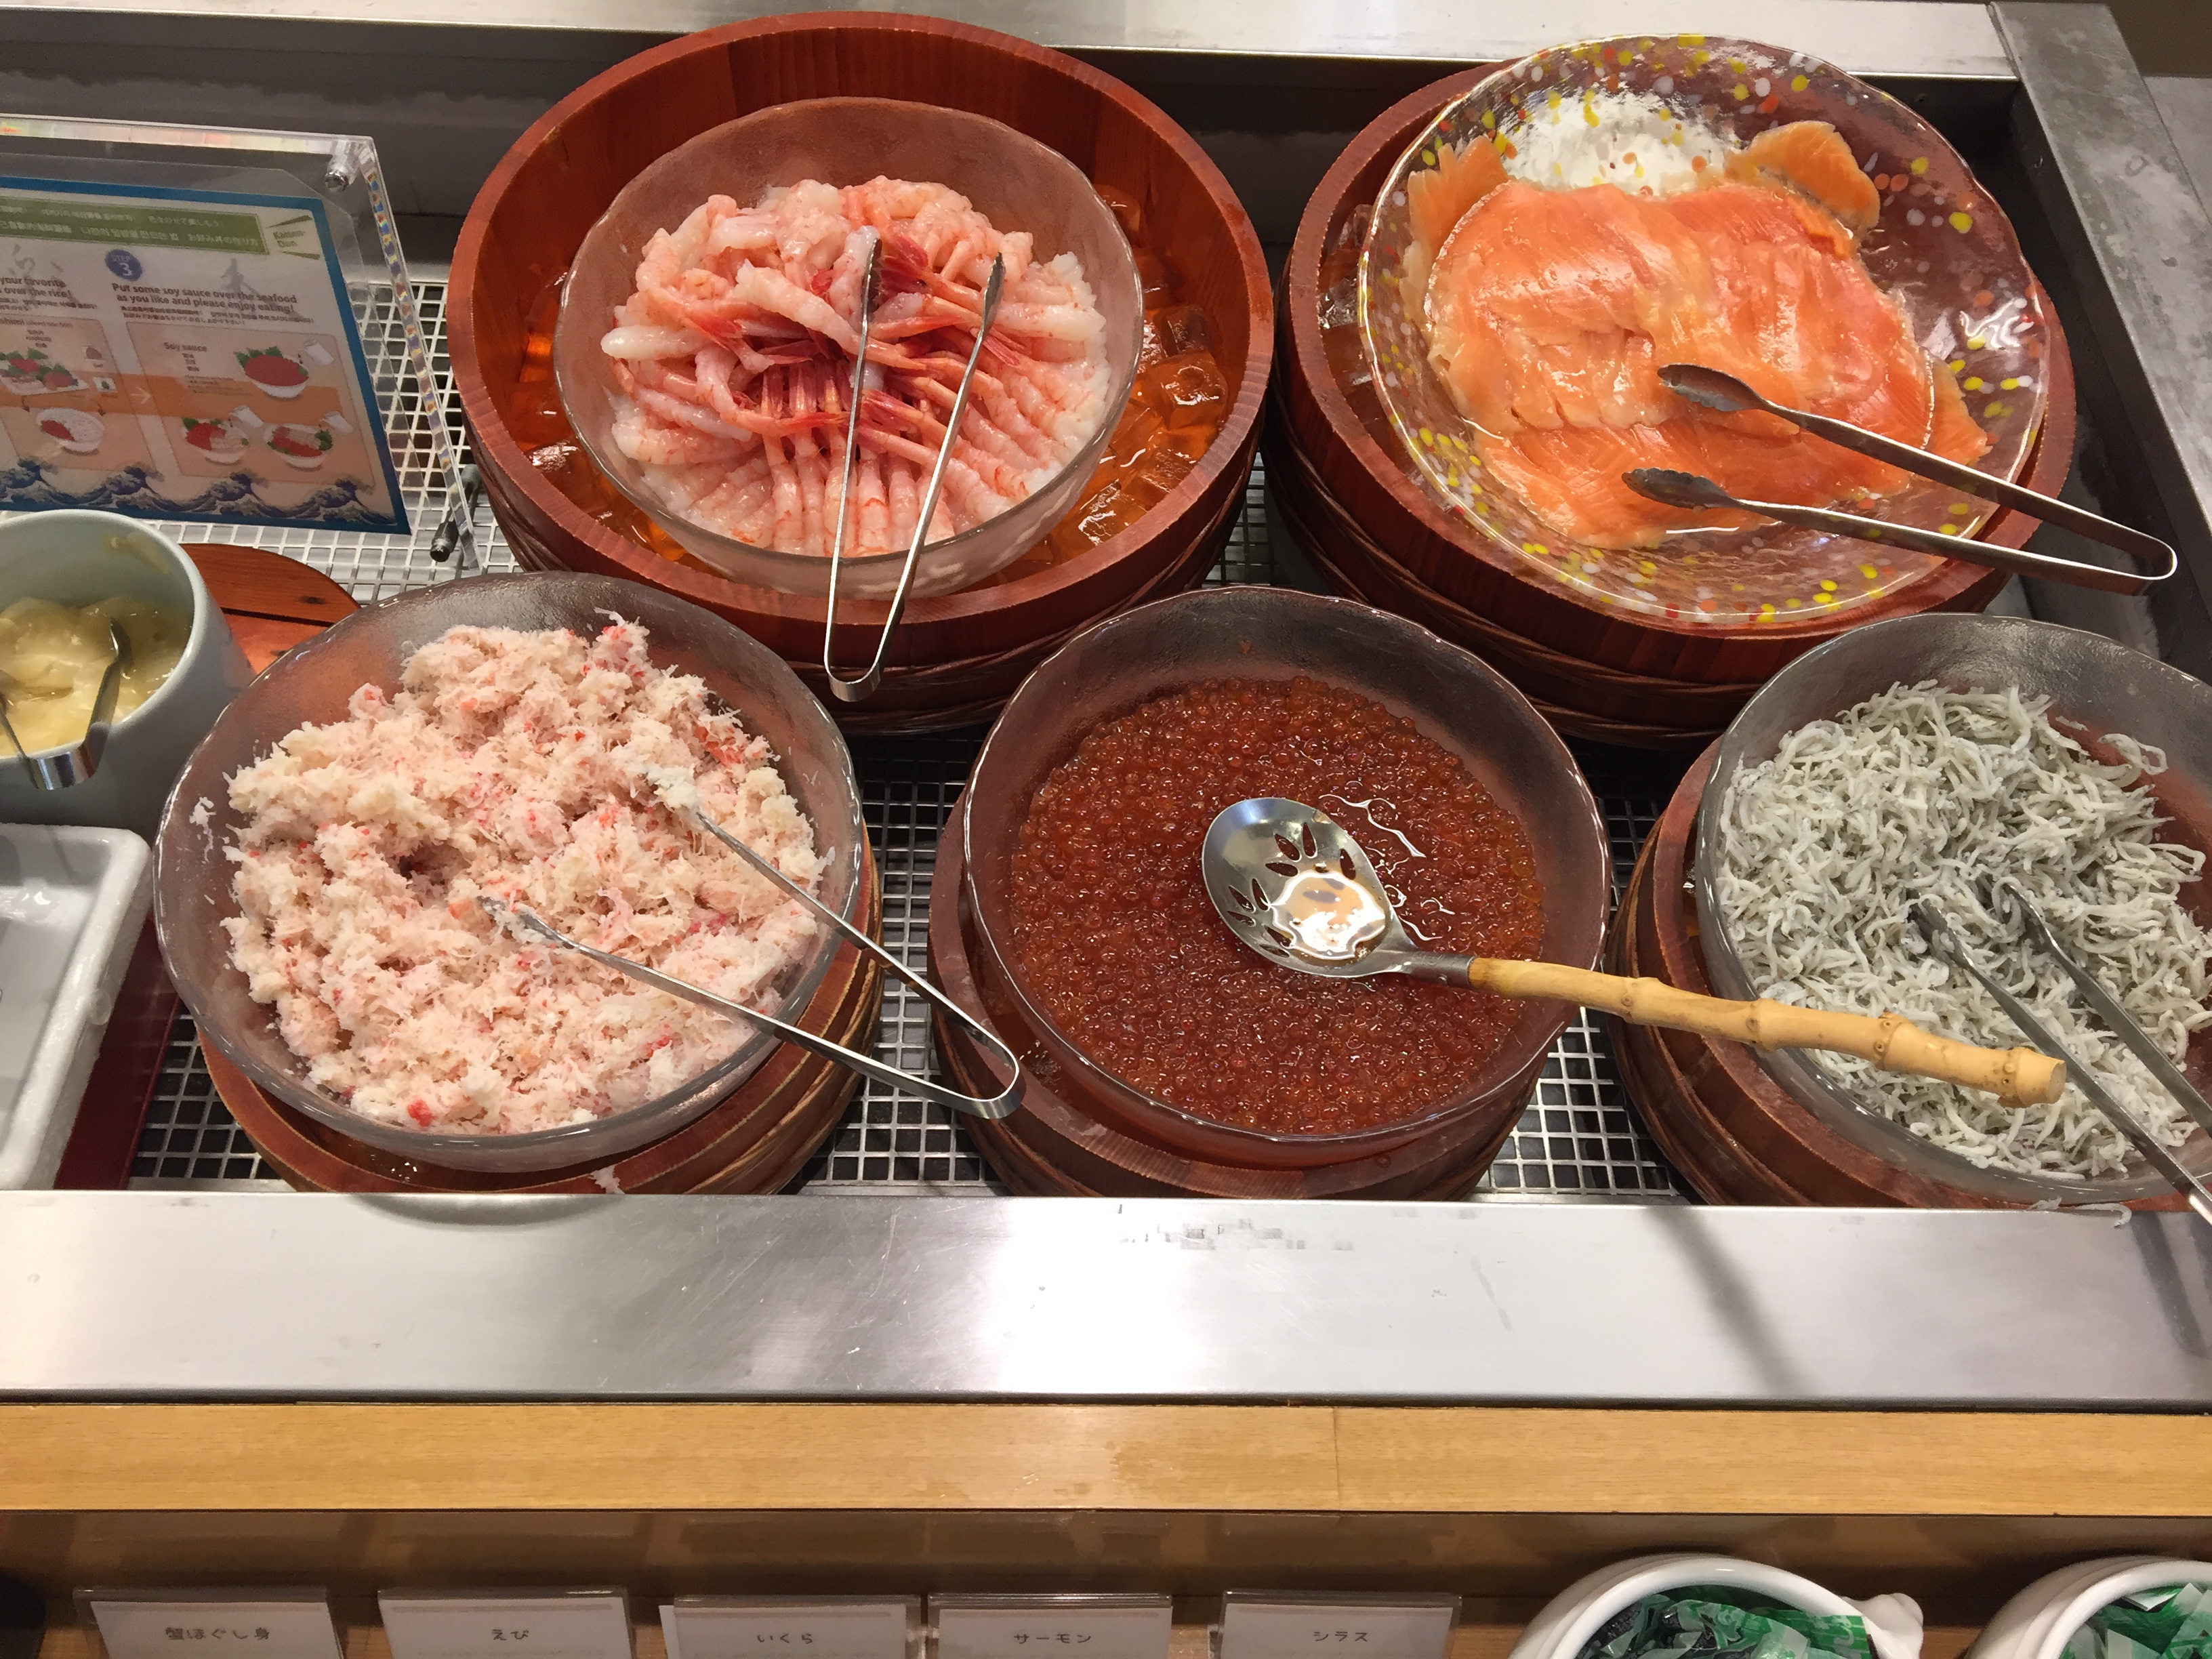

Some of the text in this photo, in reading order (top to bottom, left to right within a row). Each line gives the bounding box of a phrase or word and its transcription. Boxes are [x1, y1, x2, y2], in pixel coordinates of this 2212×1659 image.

[112, 254, 131, 262] STEP
[119, 262, 133, 276] 3
[23, 276, 66, 288] favorite
[28, 287, 47, 297] the
[111, 283, 298, 304] Put some soy sauce over the seafood
[129, 295, 150, 304] you
[150, 294, 169, 304] like
[171, 297, 192, 306] and
[192, 298, 226, 308] please
[227, 301, 256, 312] enjoy
[258, 304, 295, 316] eating!
[163, 342, 207, 352] Soy sauce
[491, 1629, 529, 1641] えび
[756, 1633, 813, 1645] いくら
[1013, 1633, 1092, 1645] サーモン
[1313, 1631, 1368, 1643] シラス
